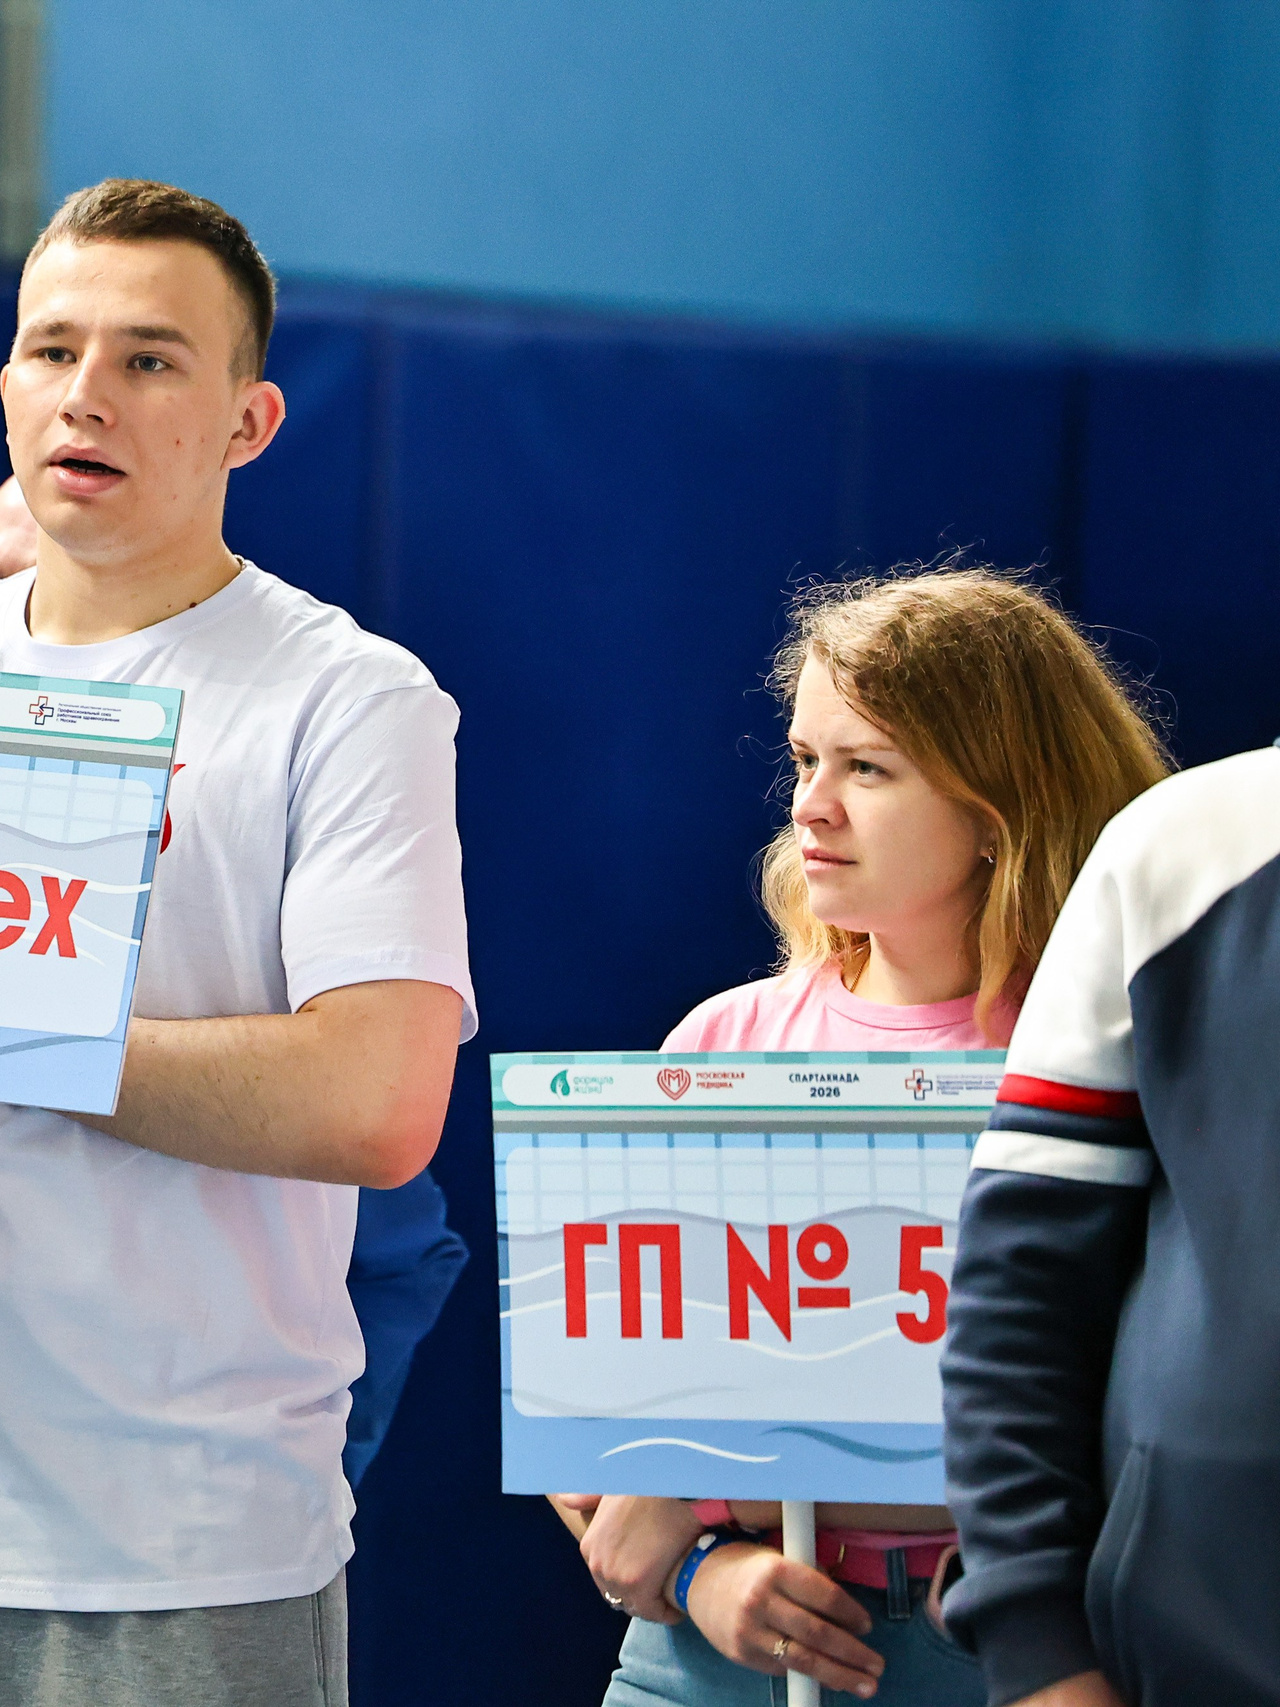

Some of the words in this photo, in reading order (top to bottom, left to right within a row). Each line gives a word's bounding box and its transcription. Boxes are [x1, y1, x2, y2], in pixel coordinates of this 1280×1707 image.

[788, 1073, 860, 1083] СПАРТАКИАДА
[810, 1087, 841, 1098] 2026
[563, 1222, 683, 1340] ГП
[726, 1222, 851, 1343] №
